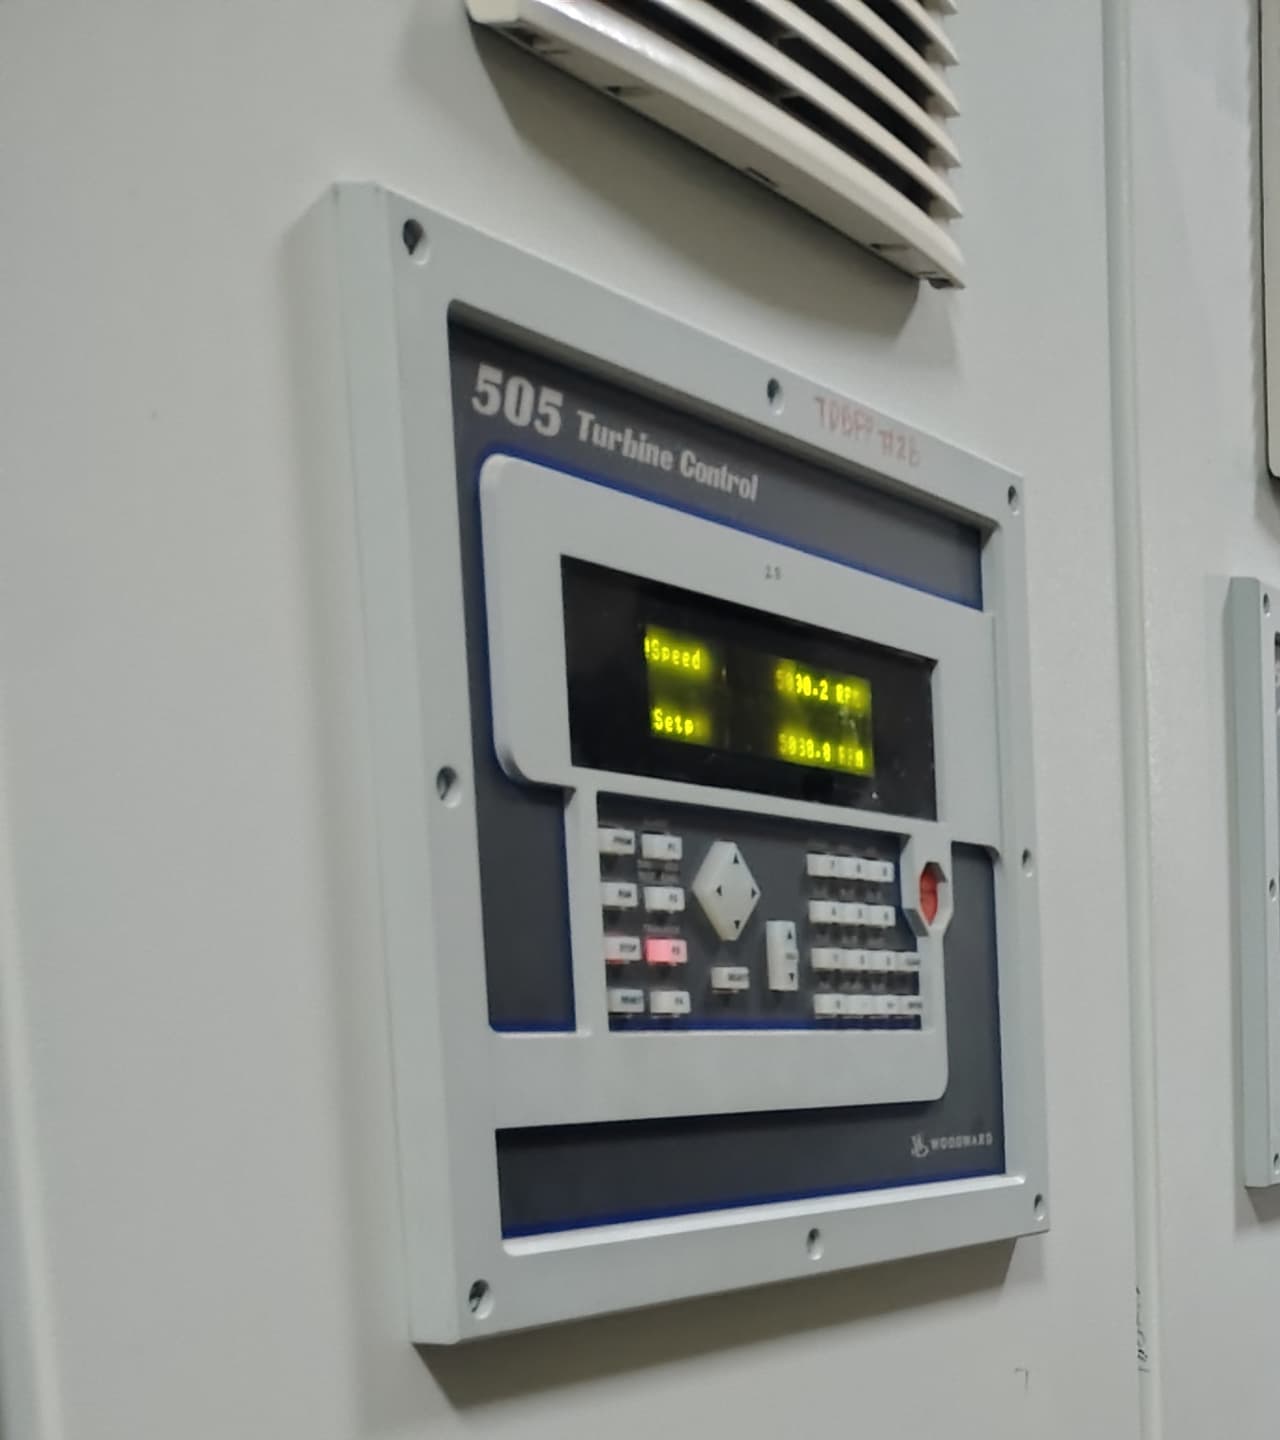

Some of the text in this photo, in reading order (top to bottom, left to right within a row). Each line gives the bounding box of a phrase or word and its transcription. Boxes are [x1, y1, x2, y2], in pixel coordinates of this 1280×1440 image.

[471, 361, 759, 501] 505 Turbine Control
[930, 1131, 994, 1151] WOODWARD
